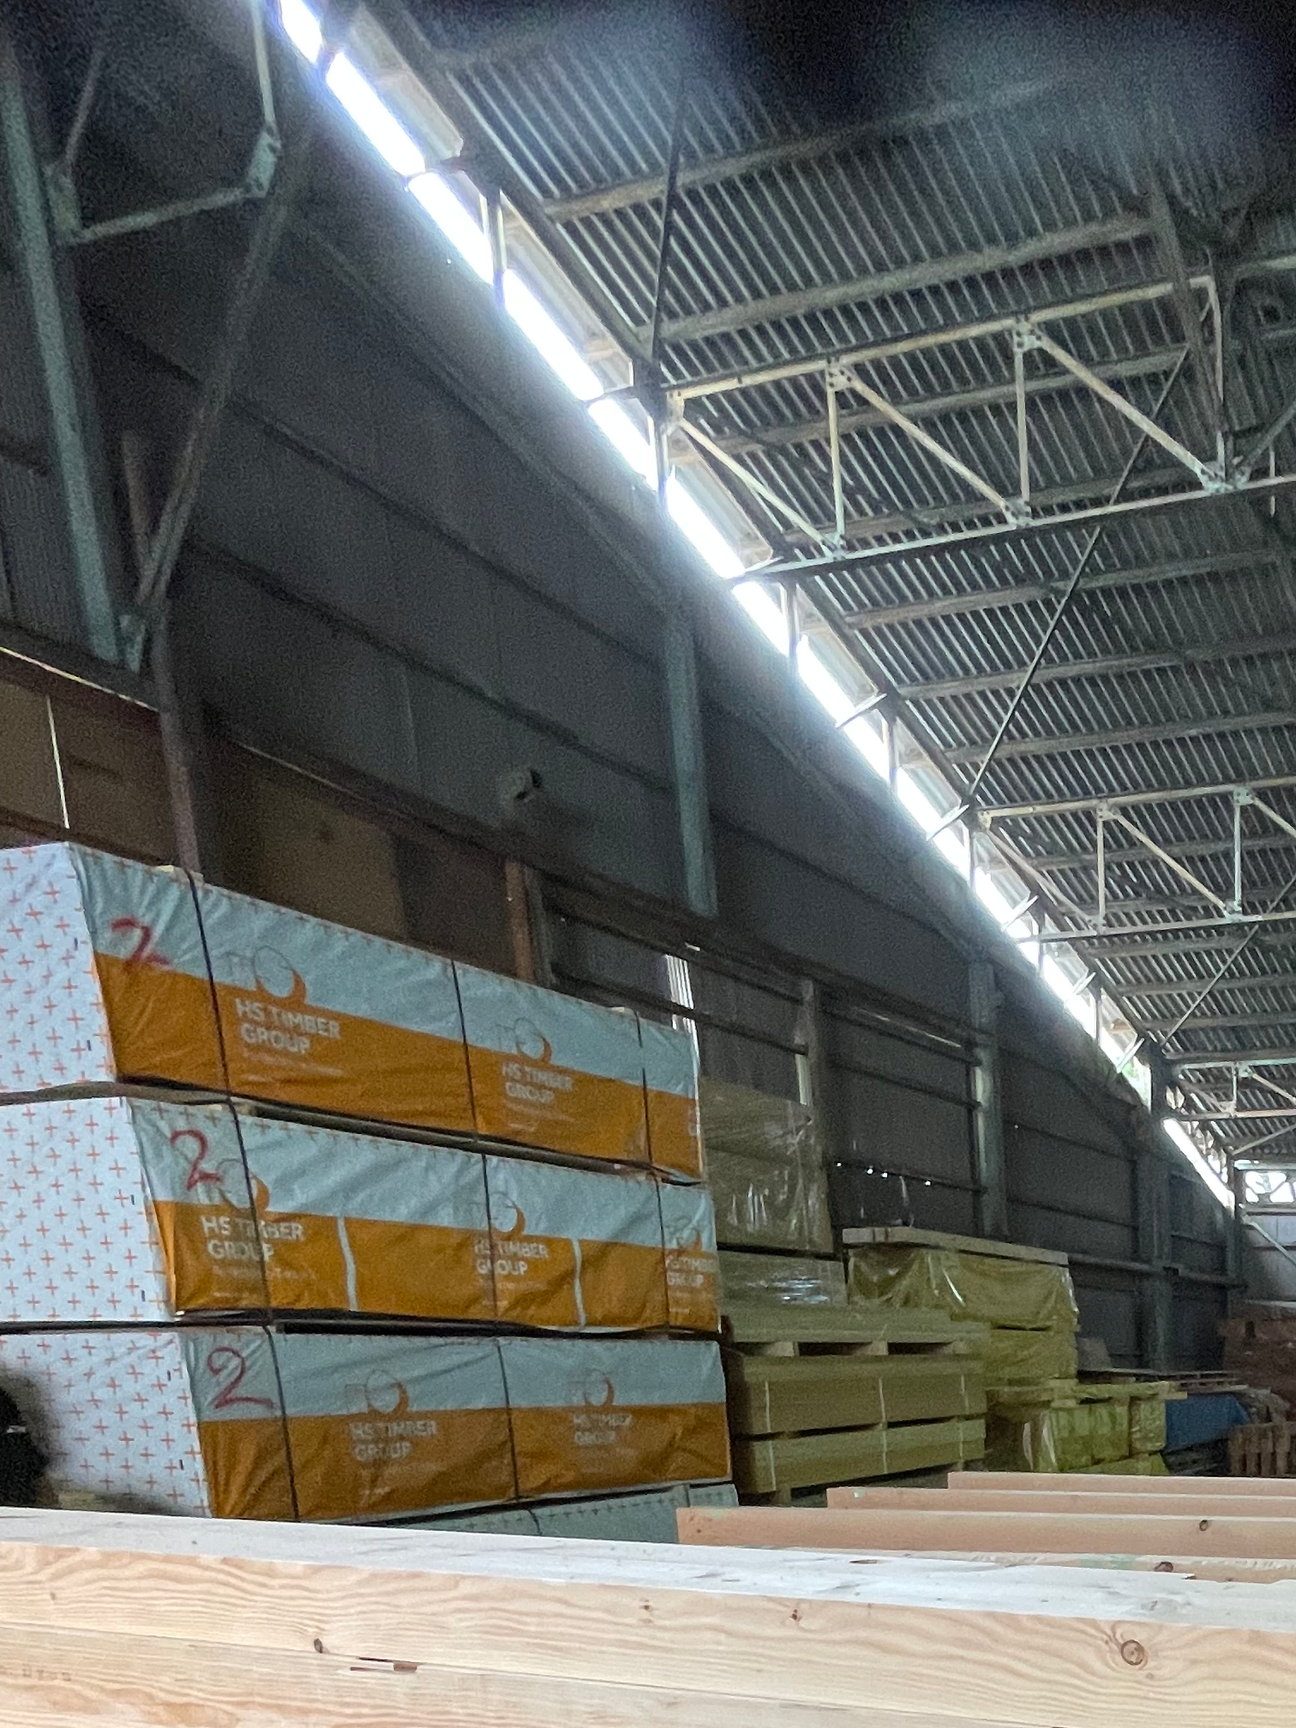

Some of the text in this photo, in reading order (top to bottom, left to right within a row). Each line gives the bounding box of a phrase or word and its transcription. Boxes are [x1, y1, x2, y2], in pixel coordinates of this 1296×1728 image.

[110, 916, 171, 974] 2
[236, 998, 341, 1040] HS TIMBER
[242, 1023, 311, 1055] GROUP
[169, 1129, 222, 1191] 2
[201, 1215, 231, 1236] HS
[207, 1346, 275, 1410] 2
